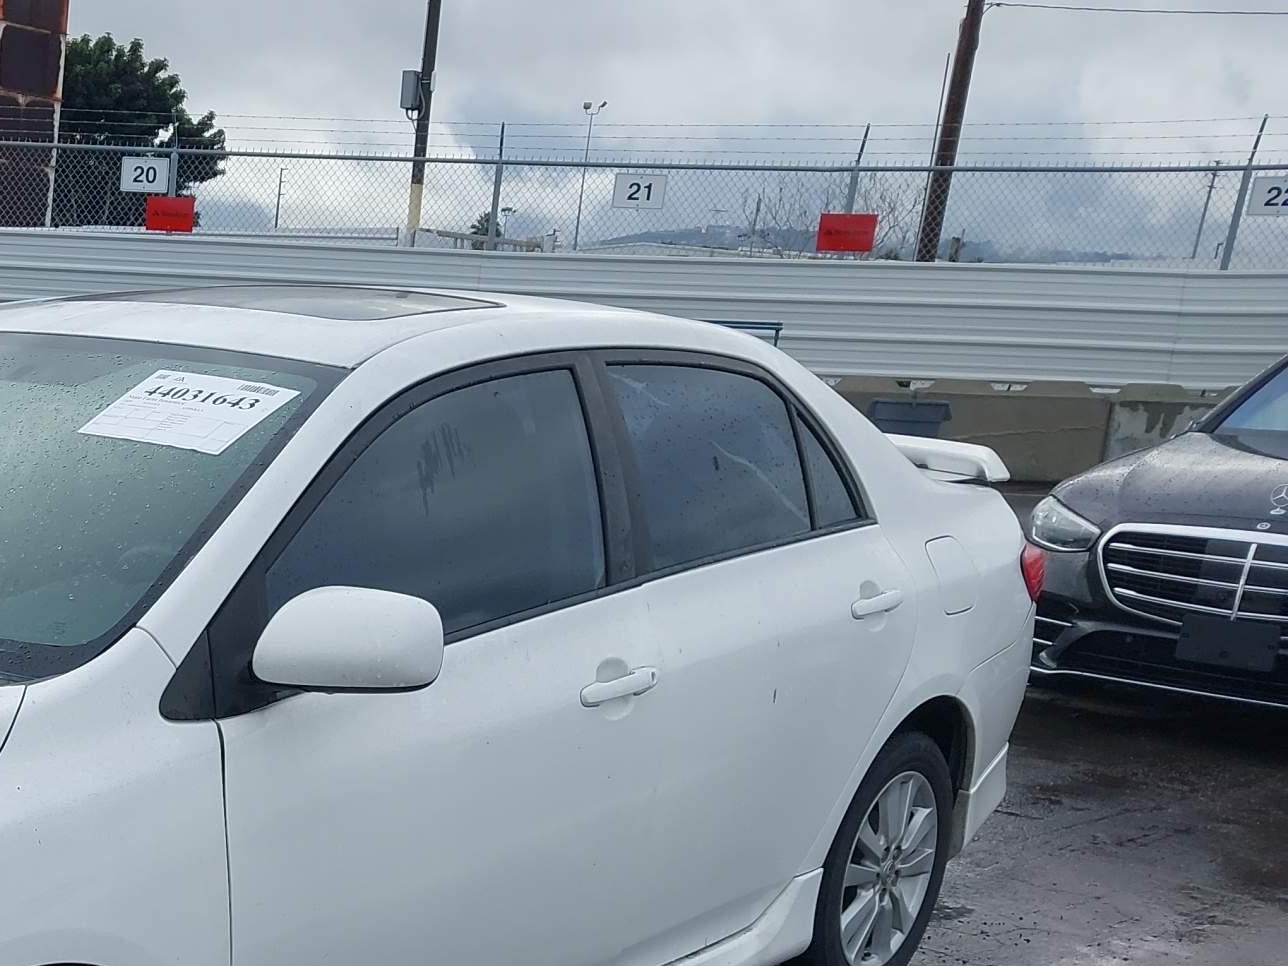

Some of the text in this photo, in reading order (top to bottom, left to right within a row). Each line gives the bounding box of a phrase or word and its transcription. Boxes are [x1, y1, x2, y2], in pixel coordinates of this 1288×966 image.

[132, 166, 157, 183] 20
[626, 182, 653, 201] 21
[144, 385, 261, 410] 44031643
